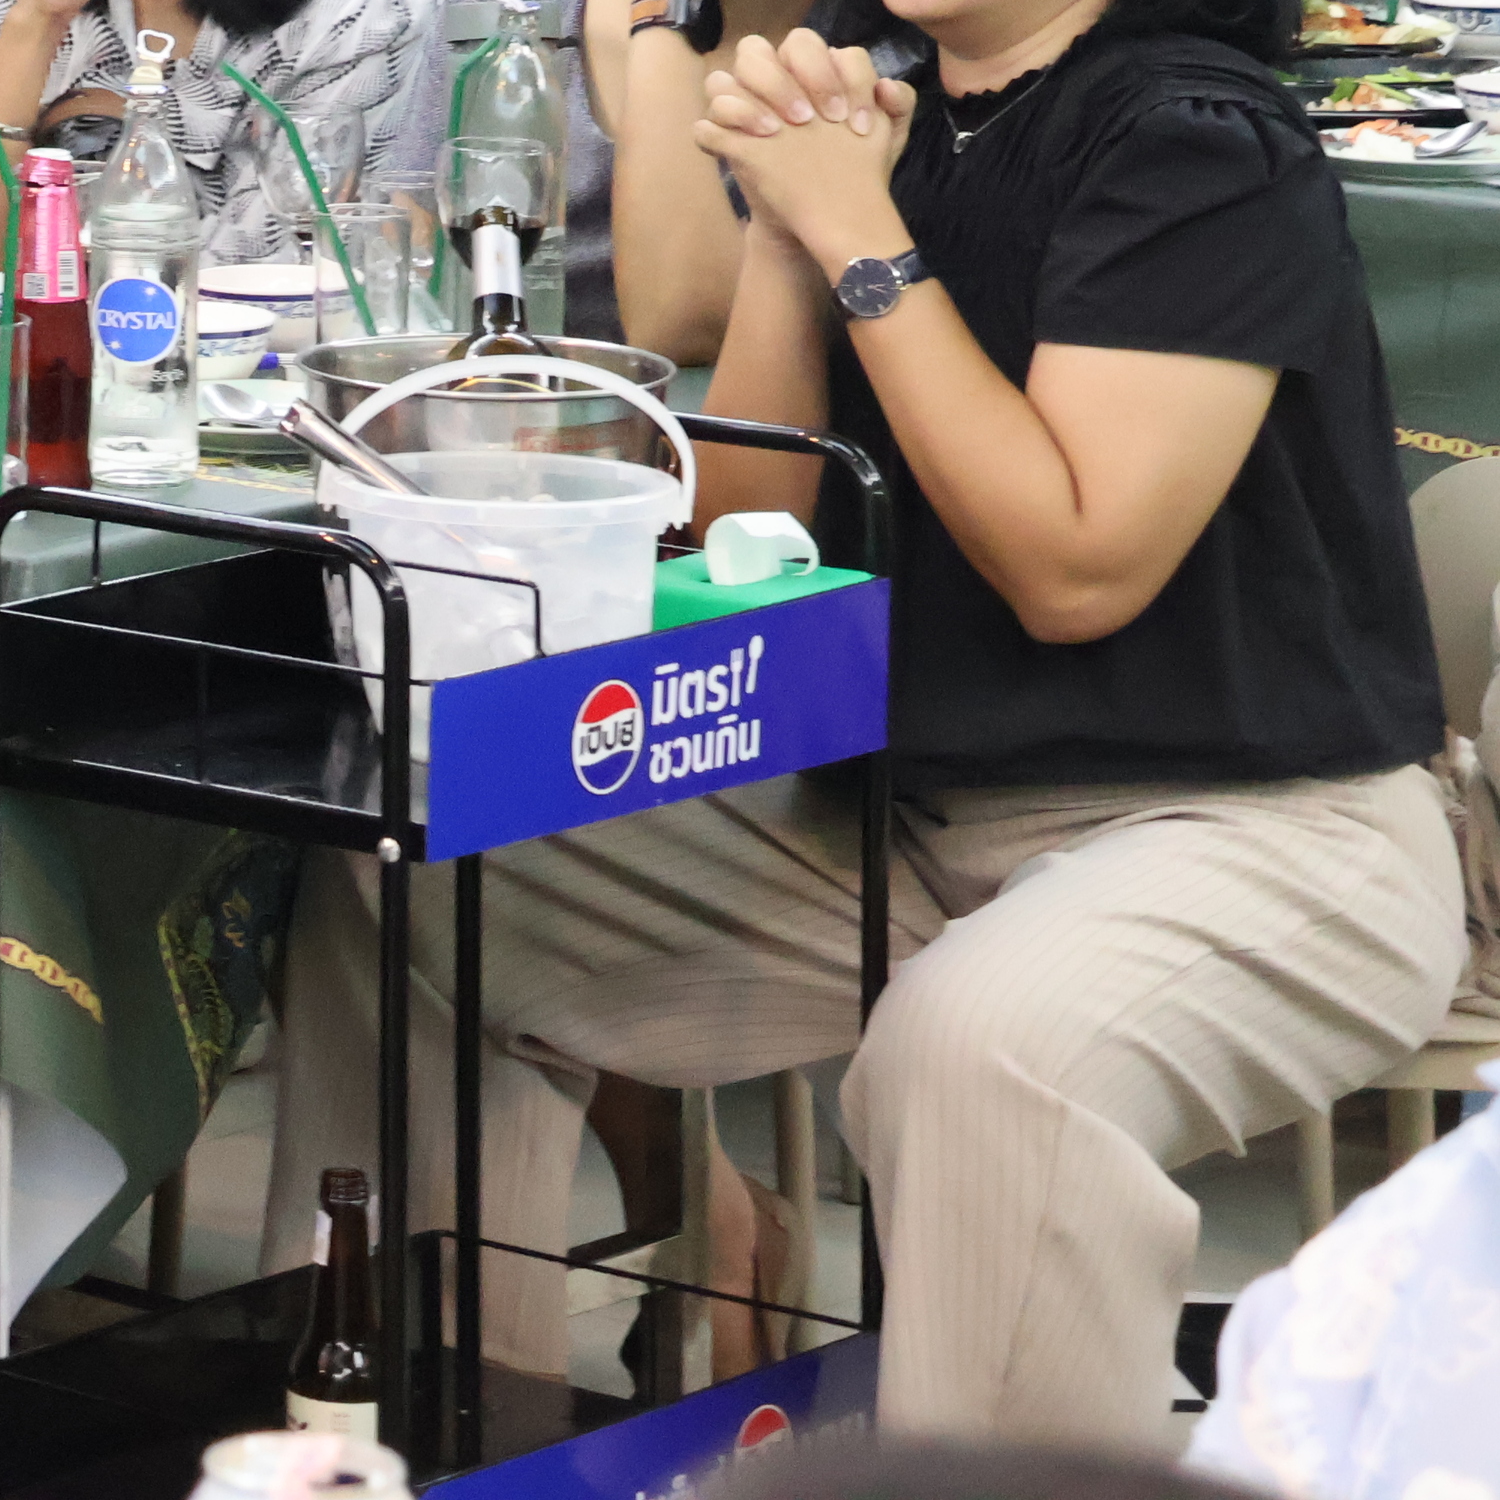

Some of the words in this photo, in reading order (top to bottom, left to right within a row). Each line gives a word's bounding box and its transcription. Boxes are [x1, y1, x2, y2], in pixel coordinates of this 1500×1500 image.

[97, 308, 176, 330] CRYSTAL
[649, 713, 762, 783] ชวนกิน
